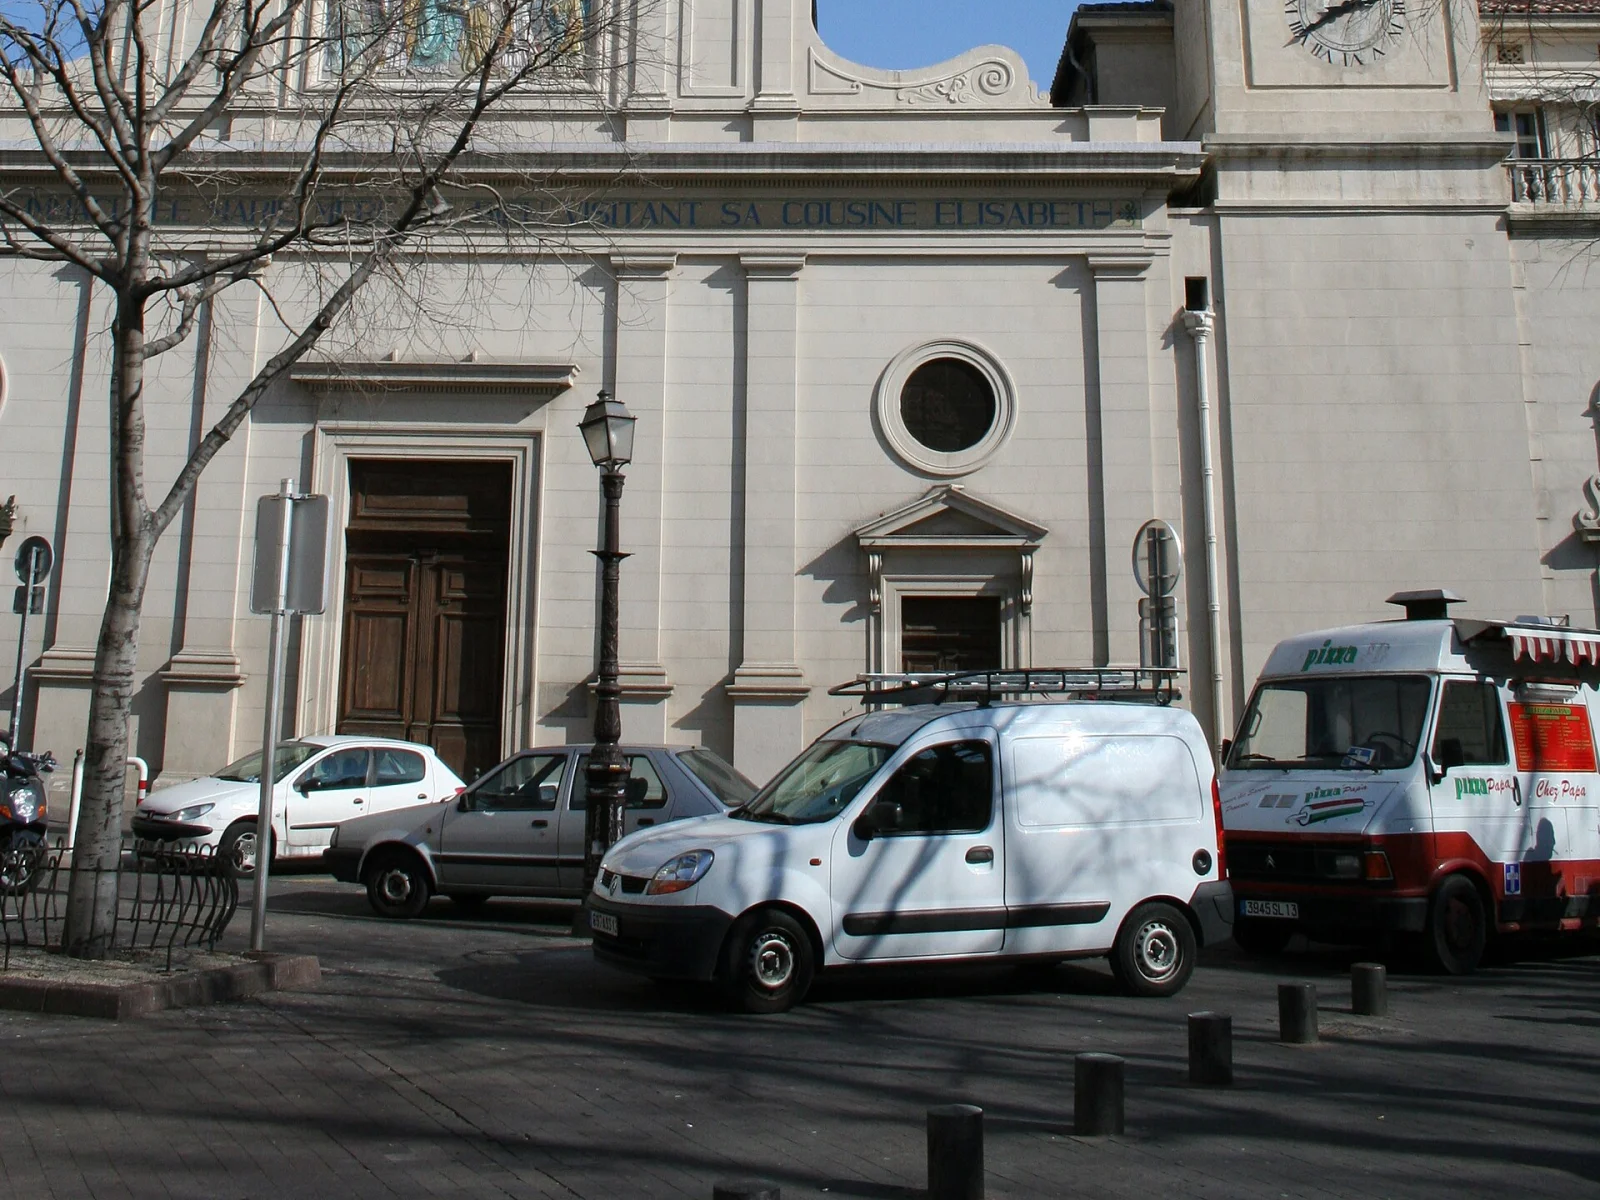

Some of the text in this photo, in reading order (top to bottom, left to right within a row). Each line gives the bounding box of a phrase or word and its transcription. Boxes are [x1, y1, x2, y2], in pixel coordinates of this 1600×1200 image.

[564, 201, 702, 227] VISITANT
[720, 201, 762, 227] SA
[782, 201, 918, 227] COUSINE
[935, 201, 1113, 227] ELISABETH
[1301, 638, 1358, 672] pizza
[1304, 786, 1341, 803] pizza
[1454, 776, 1512, 800] pizza Papa
[1536, 779, 1586, 803] Chez Papa
[1246, 901, 1298, 917] 3945 SL 13
